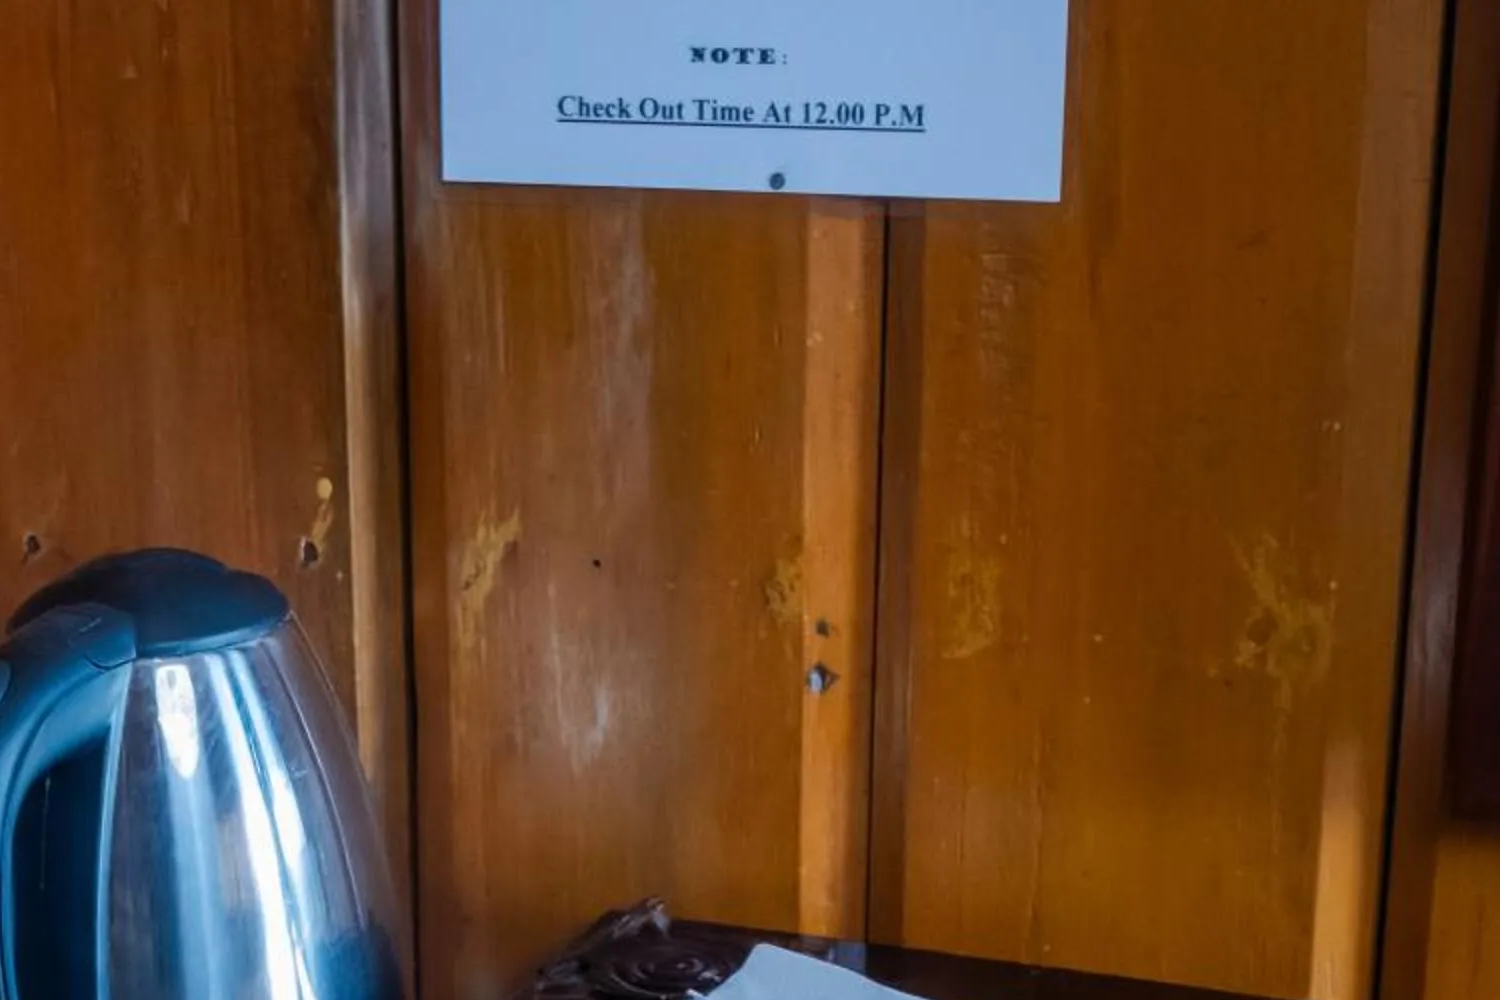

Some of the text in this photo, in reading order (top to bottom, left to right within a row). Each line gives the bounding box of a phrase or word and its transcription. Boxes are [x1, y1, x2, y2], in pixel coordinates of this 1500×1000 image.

[689, 46, 788, 65] NOTE:
[557, 95, 924, 127] Check Out Time At 12.00 P.M
